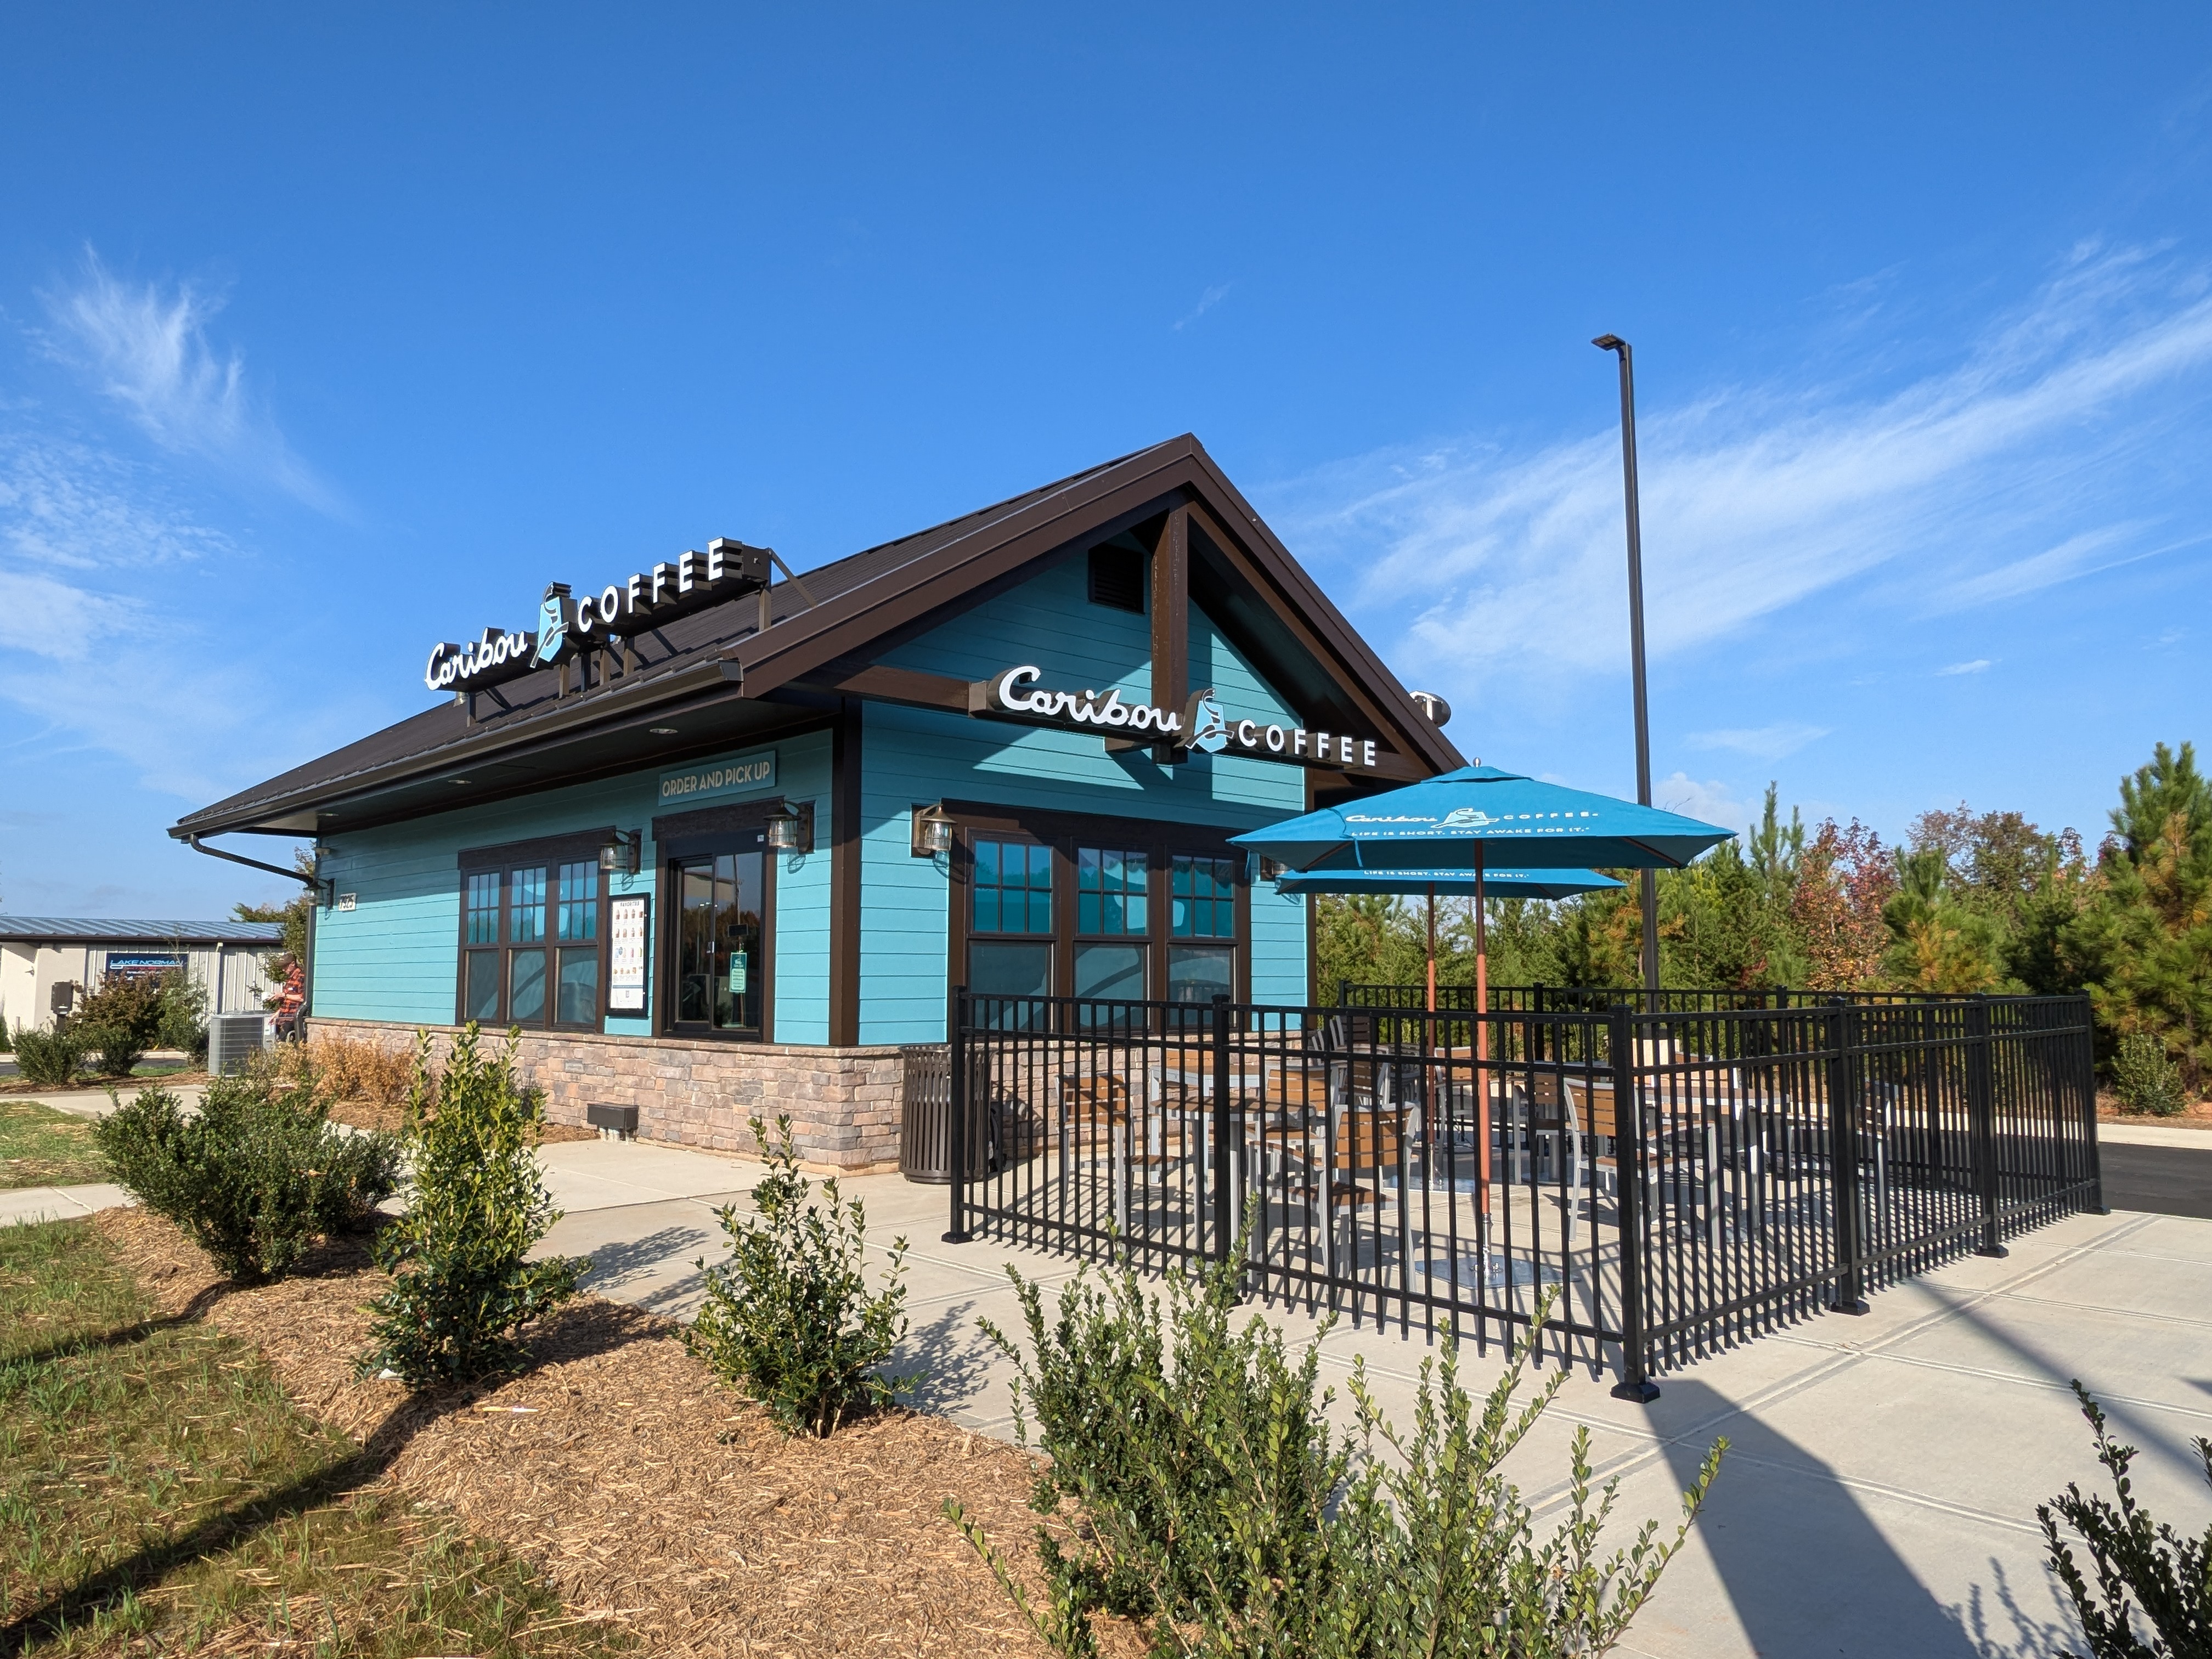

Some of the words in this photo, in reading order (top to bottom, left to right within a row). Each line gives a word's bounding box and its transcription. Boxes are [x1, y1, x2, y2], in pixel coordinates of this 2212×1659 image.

[424, 627, 528, 691] Caribou
[578, 537, 724, 633] COFFEE
[998, 665, 1182, 732] Caribou
[1238, 718, 1377, 766] COFFEE
[662, 775, 697, 797] ORDER
[699, 770, 723, 790] AND
[725, 764, 752, 786] PICK
[754, 761, 770, 781] UP
[1503, 811, 1590, 821] COFFEE
